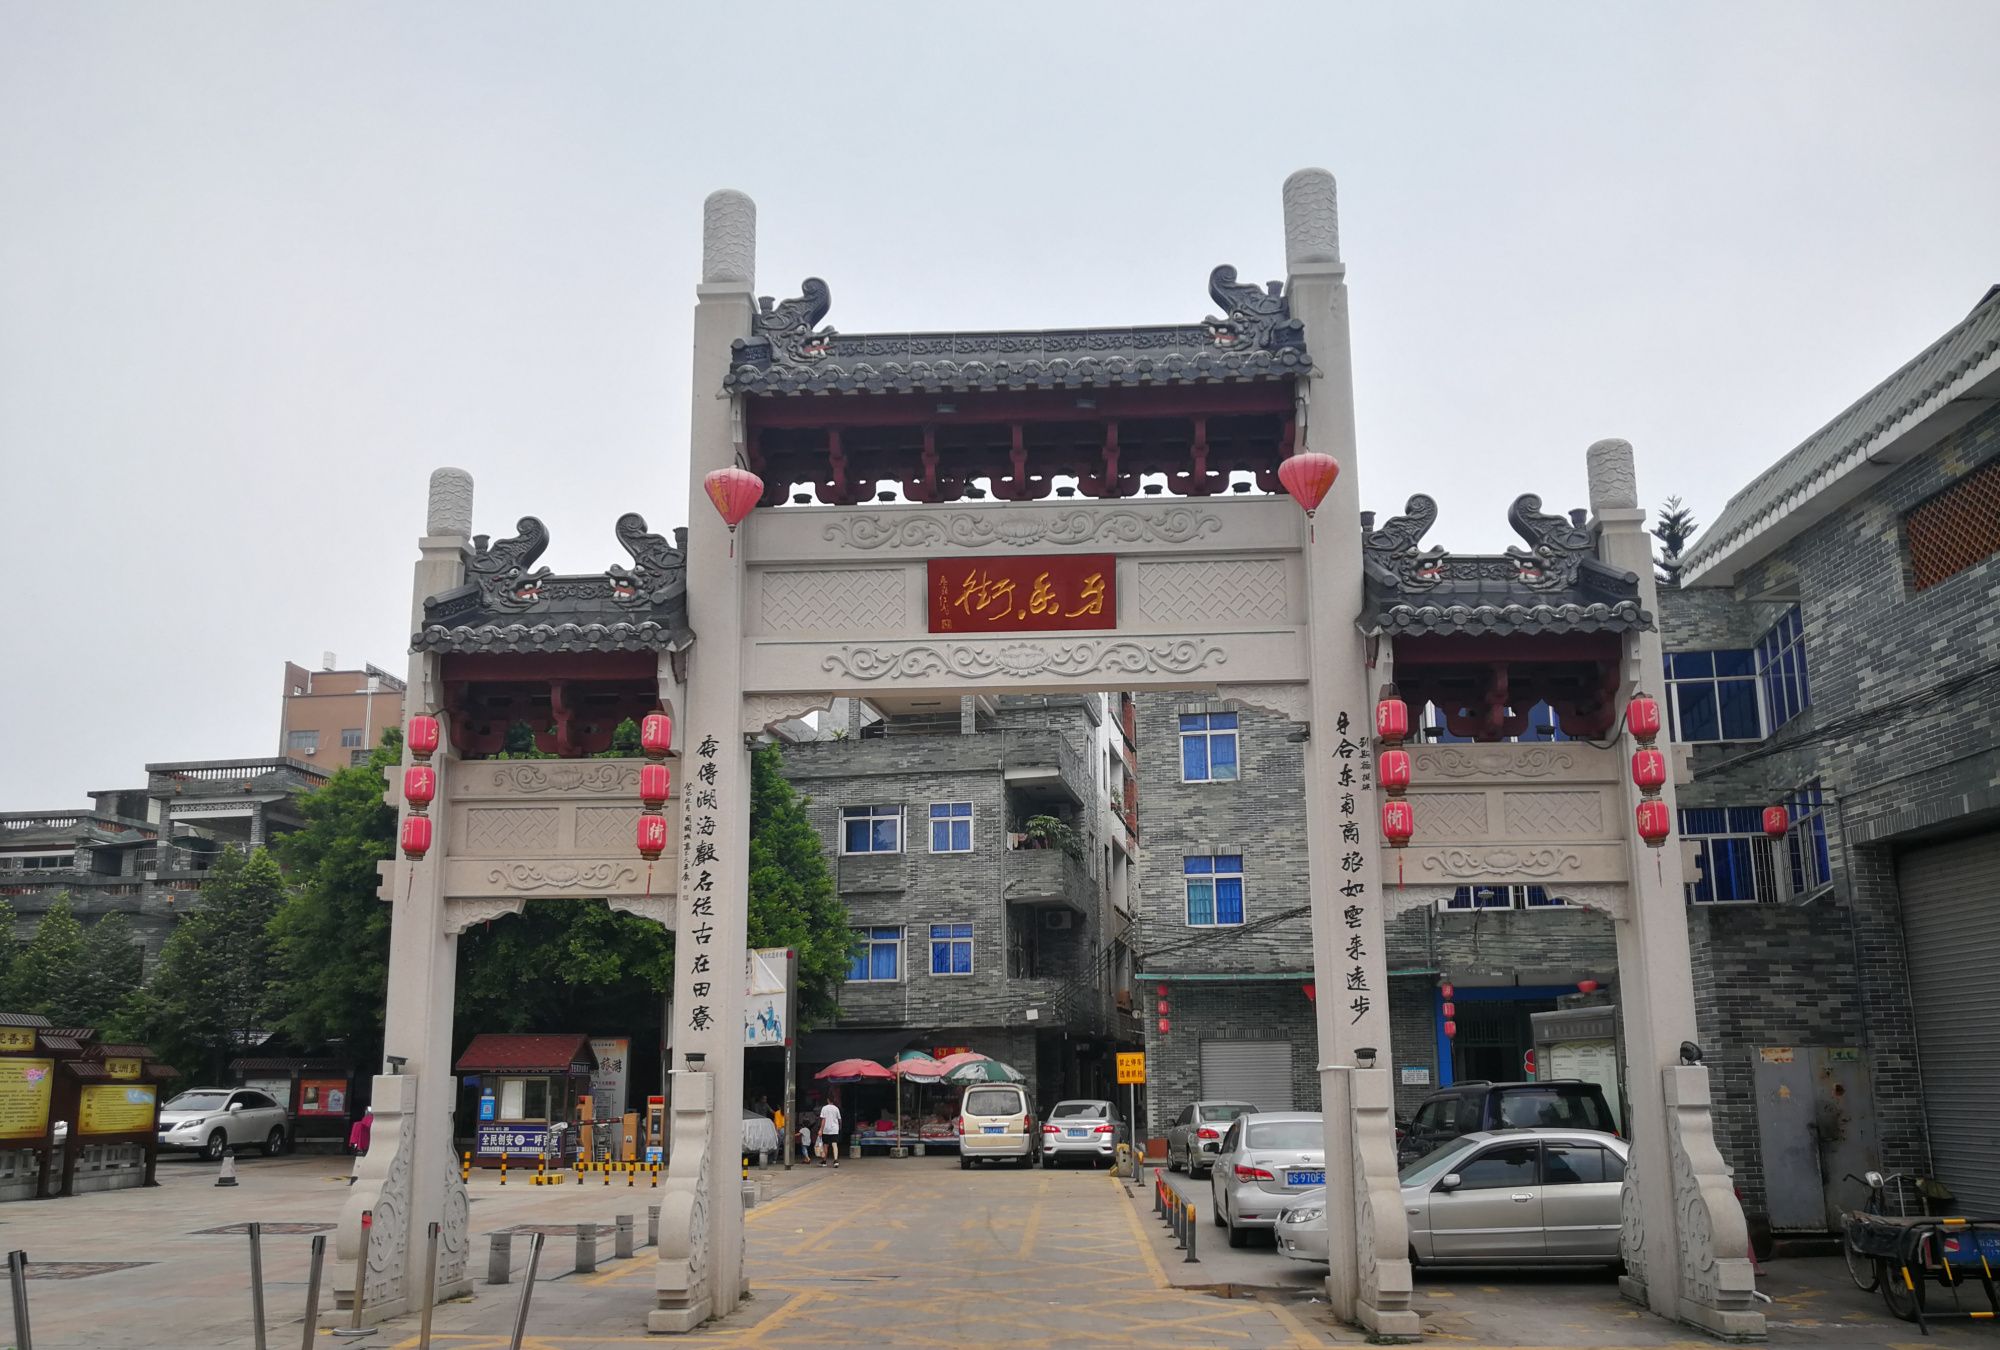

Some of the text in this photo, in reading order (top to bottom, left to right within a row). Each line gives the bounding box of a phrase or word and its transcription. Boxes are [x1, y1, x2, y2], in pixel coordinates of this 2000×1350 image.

[954, 569, 1106, 621] 牙香街
[481, 1133, 514, 1146] 全民创安
